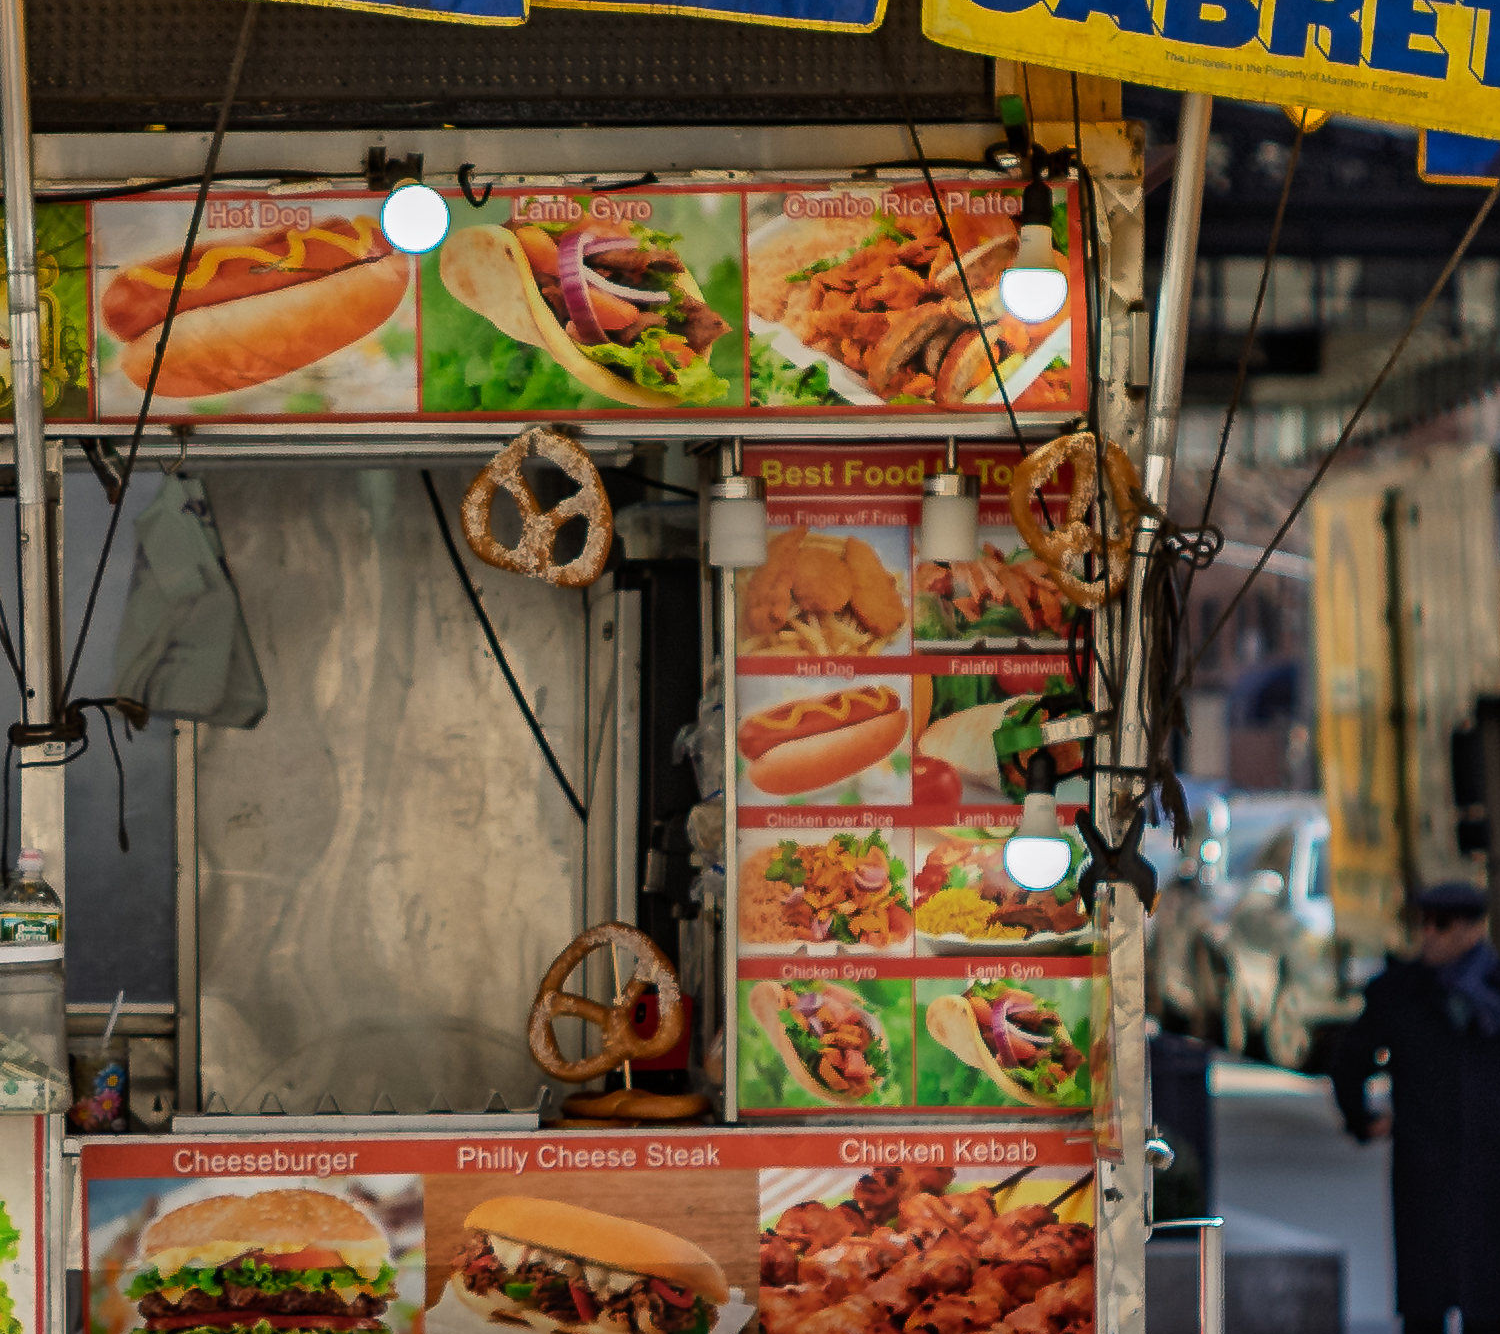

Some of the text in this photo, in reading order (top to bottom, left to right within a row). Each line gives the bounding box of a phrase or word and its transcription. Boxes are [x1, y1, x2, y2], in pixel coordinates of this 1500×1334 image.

[1165, 50, 1185, 64] This
[1234, 61, 1244, 72] is
[1246, 63, 1262, 75] the
[1264, 64, 1307, 83] Property
[1309, 72, 1320, 83] of
[1321, 74, 1369, 90] Marathon
[1371, 81, 1430, 100] Enterprises
[206, 202, 312, 232] Hot Dog
[511, 196, 653, 225] Lamb Gyro
[784, 193, 875, 218] Combo
[881, 192, 936, 217] Rice
[760, 459, 834, 487] Best
[844, 459, 924, 487] Food
[797, 660, 855, 680] Hot Dog
[949, 658, 1071, 676] Falafel Sandwich
[766, 812, 894, 829] Chicken over Rice
[955, 812, 992, 828] Lamb
[781, 964, 878, 984] Chicken Gyro
[966, 963, 1045, 981] Lamb Gyro
[172, 1146, 359, 1178] Cheeseburger
[456, 1141, 721, 1174] Philly Cheese Steak
[838, 1136, 1038, 1166] Chicken Kebab
